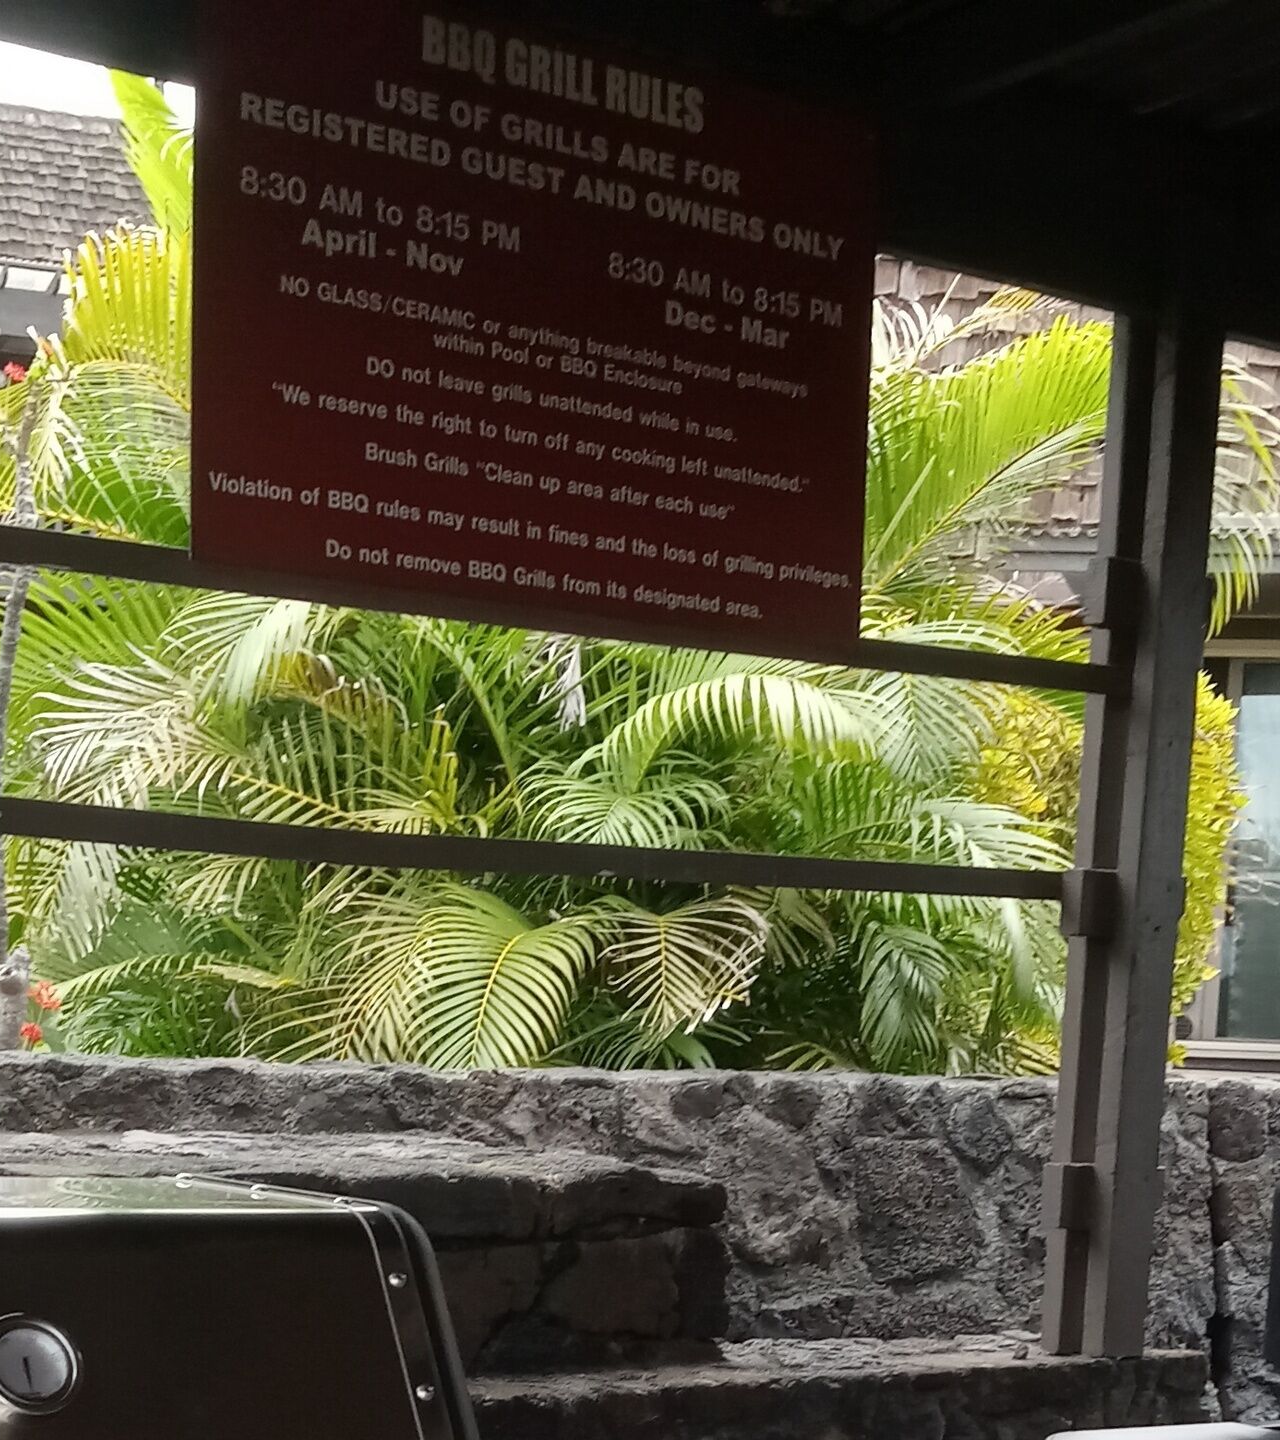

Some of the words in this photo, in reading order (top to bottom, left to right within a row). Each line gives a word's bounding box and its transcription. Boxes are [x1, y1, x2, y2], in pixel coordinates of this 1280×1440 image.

[422, 14, 495, 84] BBQ
[506, 38, 597, 105] GRILL
[606, 64, 704, 133] RULES
[241, 91, 450, 167] REGISTERED
[461, 147, 565, 194] GUEST
[574, 175, 636, 211] AND
[645, 191, 765, 243] OWNERS
[773, 223, 845, 261] ONLY
[376, 80, 440, 121] USE
[450, 100, 490, 132] OF
[501, 113, 608, 163] GRILLS
[617, 143, 675, 180] ARE
[685, 160, 740, 196] FOR
[240, 165, 307, 205] 8:30
[319, 184, 363, 218] AM
[376, 197, 403, 227] to
[416, 205, 470, 242] 8:15
[482, 220, 521, 252] PM
[301, 218, 377, 258] April
[406, 239, 464, 276] Nov
[280, 275, 310, 298] NO
[317, 282, 476, 331] GLASS/CERAMIC
[483, 319, 501, 335] or
[508, 322, 579, 354] anything
[586, 337, 667, 369] breakable
[673, 354, 731, 382] beyond
[608, 251, 664, 287] 8:30
[673, 267, 711, 298] AM
[722, 279, 745, 305] to
[753, 286, 800, 318] 8:15
[810, 298, 843, 327] PM
[665, 301, 716, 334] Dec
[740, 316, 790, 349] Mar
[366, 355, 395, 378] DO
[402, 367, 431, 386] not
[438, 370, 485, 395] leave
[491, 382, 532, 404] grills
[539, 391, 633, 422] unattended
[639, 410, 679, 431] while
[685, 417, 700, 435] in
[705, 424, 738, 442] use.
[433, 333, 484, 357] within
[491, 340, 529, 365] Pool
[535, 354, 552, 369] or
[560, 355, 597, 378] BBQ
[604, 366, 683, 395] Enclosure
[318, 393, 388, 420] reserve
[395, 404, 425, 425] the
[431, 411, 472, 435] right
[479, 419, 497, 438] to
[504, 423, 537, 446] turn
[544, 432, 569, 451] off
[575, 439, 605, 460] any
[611, 445, 676, 475] cooking
[681, 455, 708, 477] left
[365, 442, 417, 469] Brush
[424, 451, 469, 477] Grills
[539, 475, 560, 494] up
[567, 481, 604, 499] area
[610, 486, 650, 506] after
[655, 496, 693, 515] each
[208, 471, 292, 502] Violation
[300, 487, 320, 506] of
[327, 489, 369, 513] BBQ
[376, 499, 421, 521] rules
[427, 508, 464, 531] may
[471, 514, 519, 537] result
[527, 521, 541, 540] in
[548, 525, 589, 548] fines
[595, 535, 625, 554] and
[631, 538, 657, 559] the
[663, 542, 696, 564] loss
[702, 549, 719, 568] of
[724, 554, 774, 580] grilling
[325, 538, 352, 560] Do
[358, 547, 389, 566] not
[395, 553, 462, 576] remove
[468, 560, 507, 583] BBQ
[513, 566, 555, 589] Grills
[562, 574, 601, 596] from
[606, 579, 627, 599] its
[633, 584, 720, 613] designated
[726, 600, 763, 620] area.
